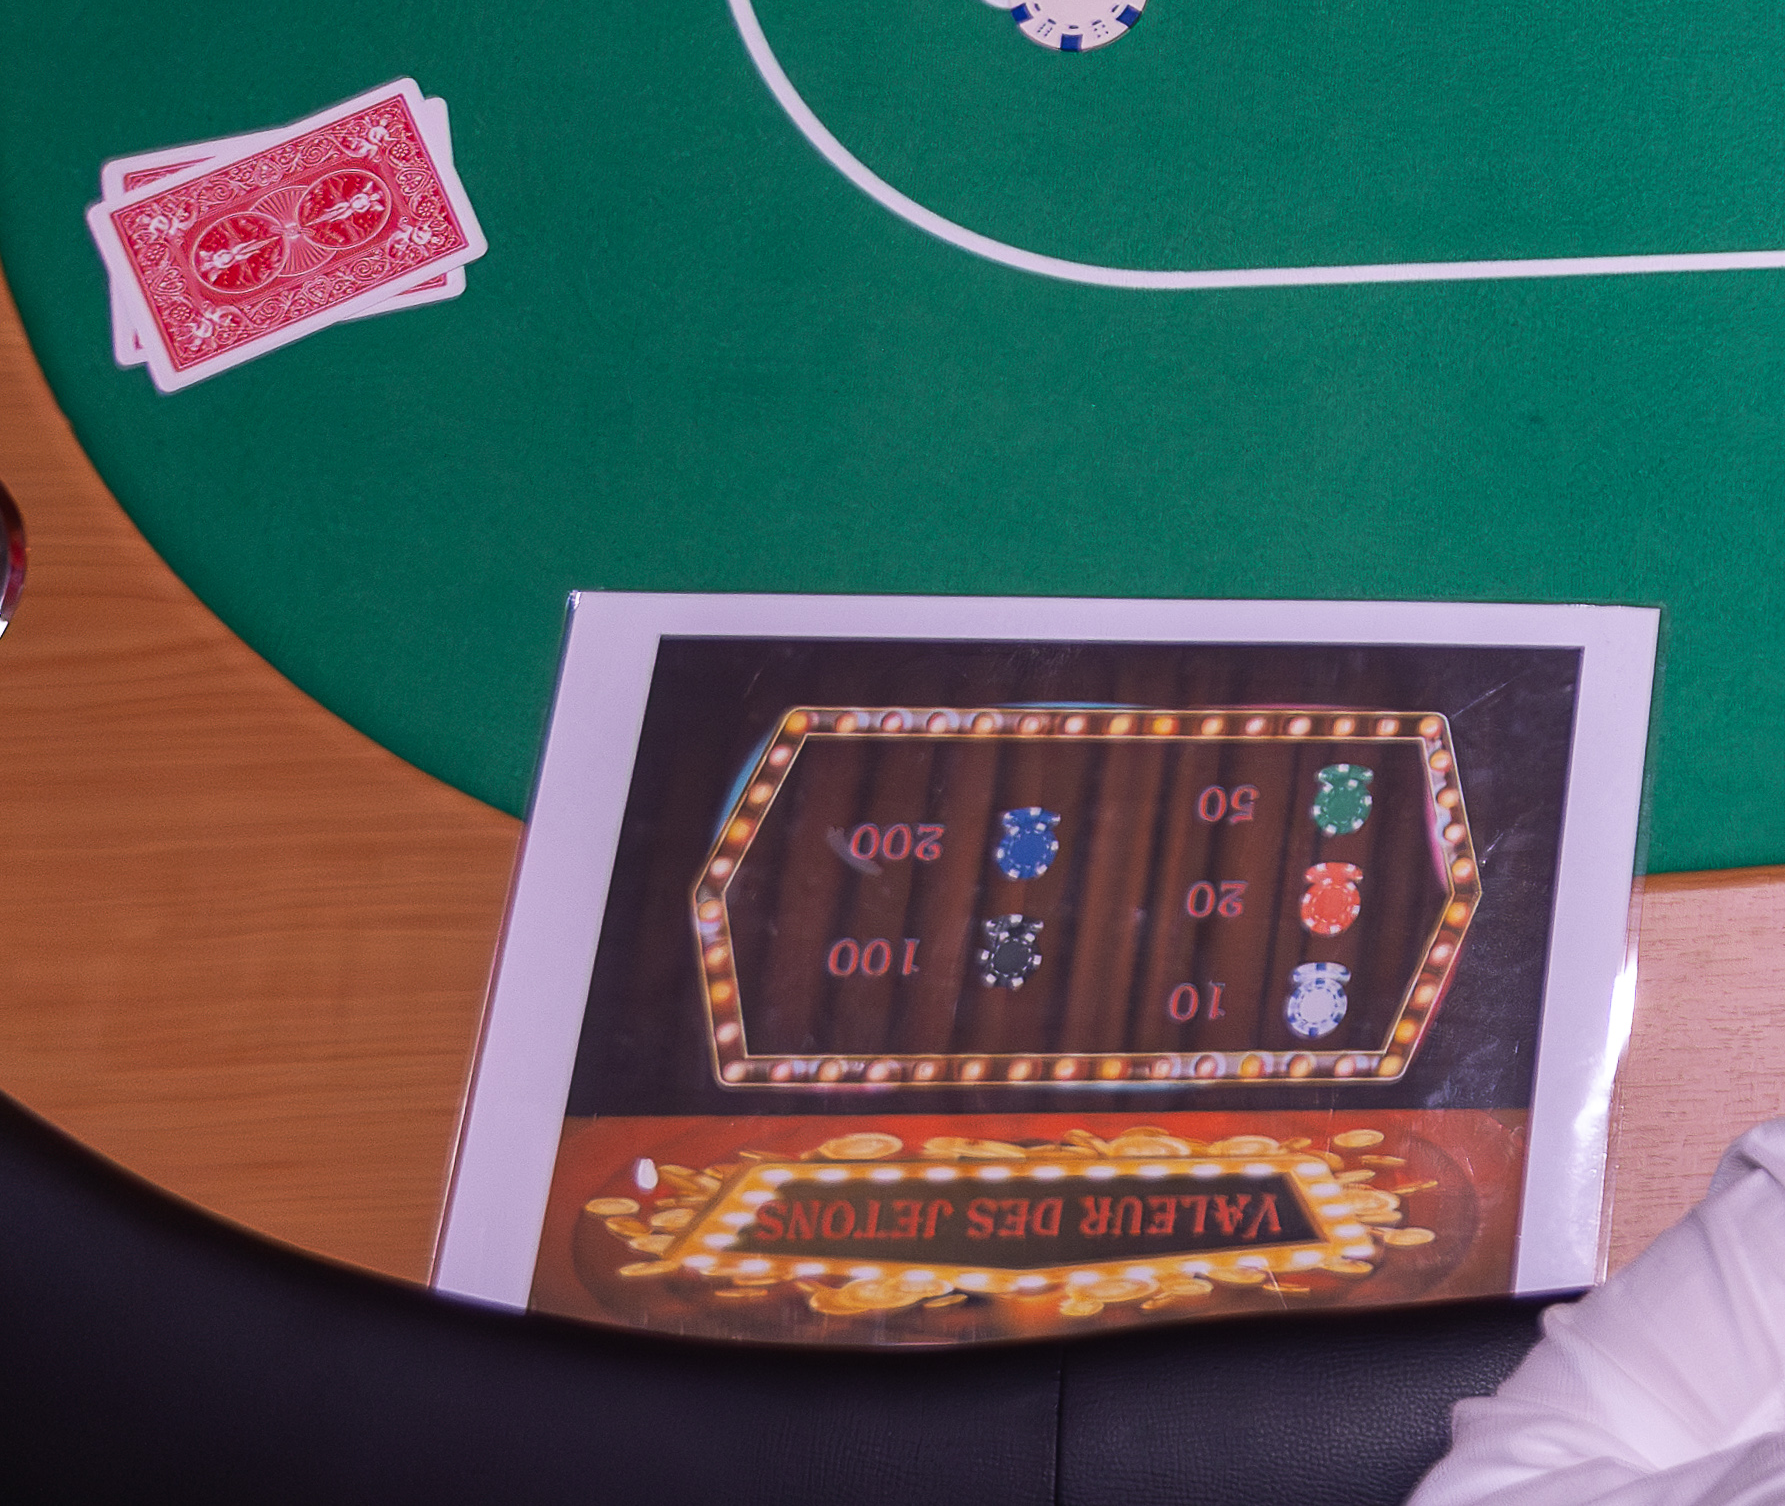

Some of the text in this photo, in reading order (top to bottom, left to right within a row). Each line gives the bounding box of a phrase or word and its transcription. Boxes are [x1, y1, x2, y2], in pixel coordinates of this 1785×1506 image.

[1198, 785, 1260, 825] 50
[851, 822, 946, 861] 200
[1186, 880, 1248, 918] 20
[828, 938, 920, 976] 100
[1169, 980, 1226, 1022] 10
[754, 1192, 1283, 1243] VALEUR DES JETONS
